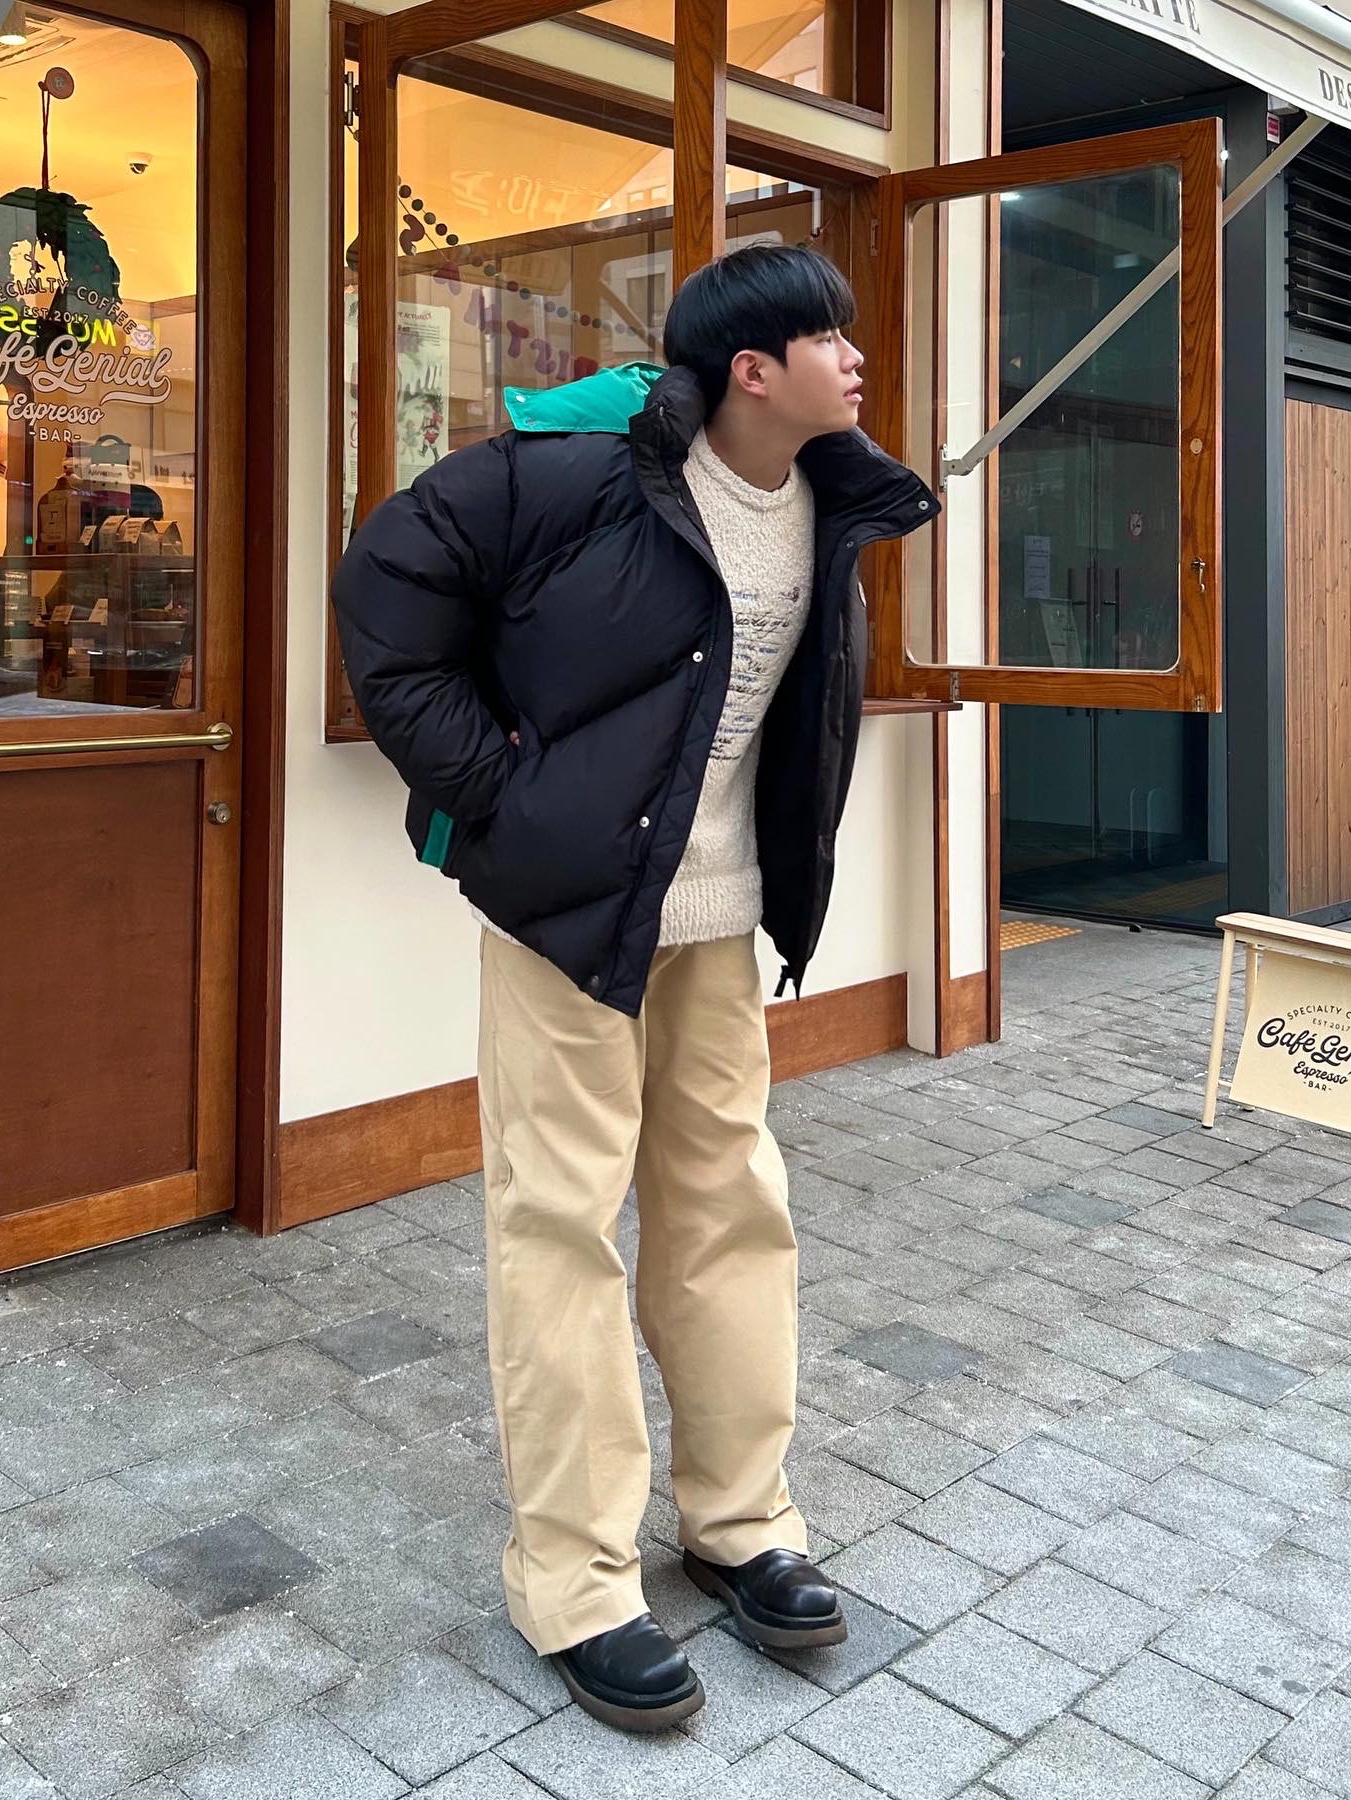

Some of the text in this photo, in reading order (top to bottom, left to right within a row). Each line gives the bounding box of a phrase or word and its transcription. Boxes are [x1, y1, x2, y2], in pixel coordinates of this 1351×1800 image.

[77, 286, 138, 335] COFFEE
[32, 335, 172, 406] Genial
[8, 393, 104, 426] Espresso
[1287, 1004, 1342, 1021] SPECIALTY
[1257, 1017, 1351, 1067] Café Ge
[1293, 1060, 1348, 1085] Espresso
